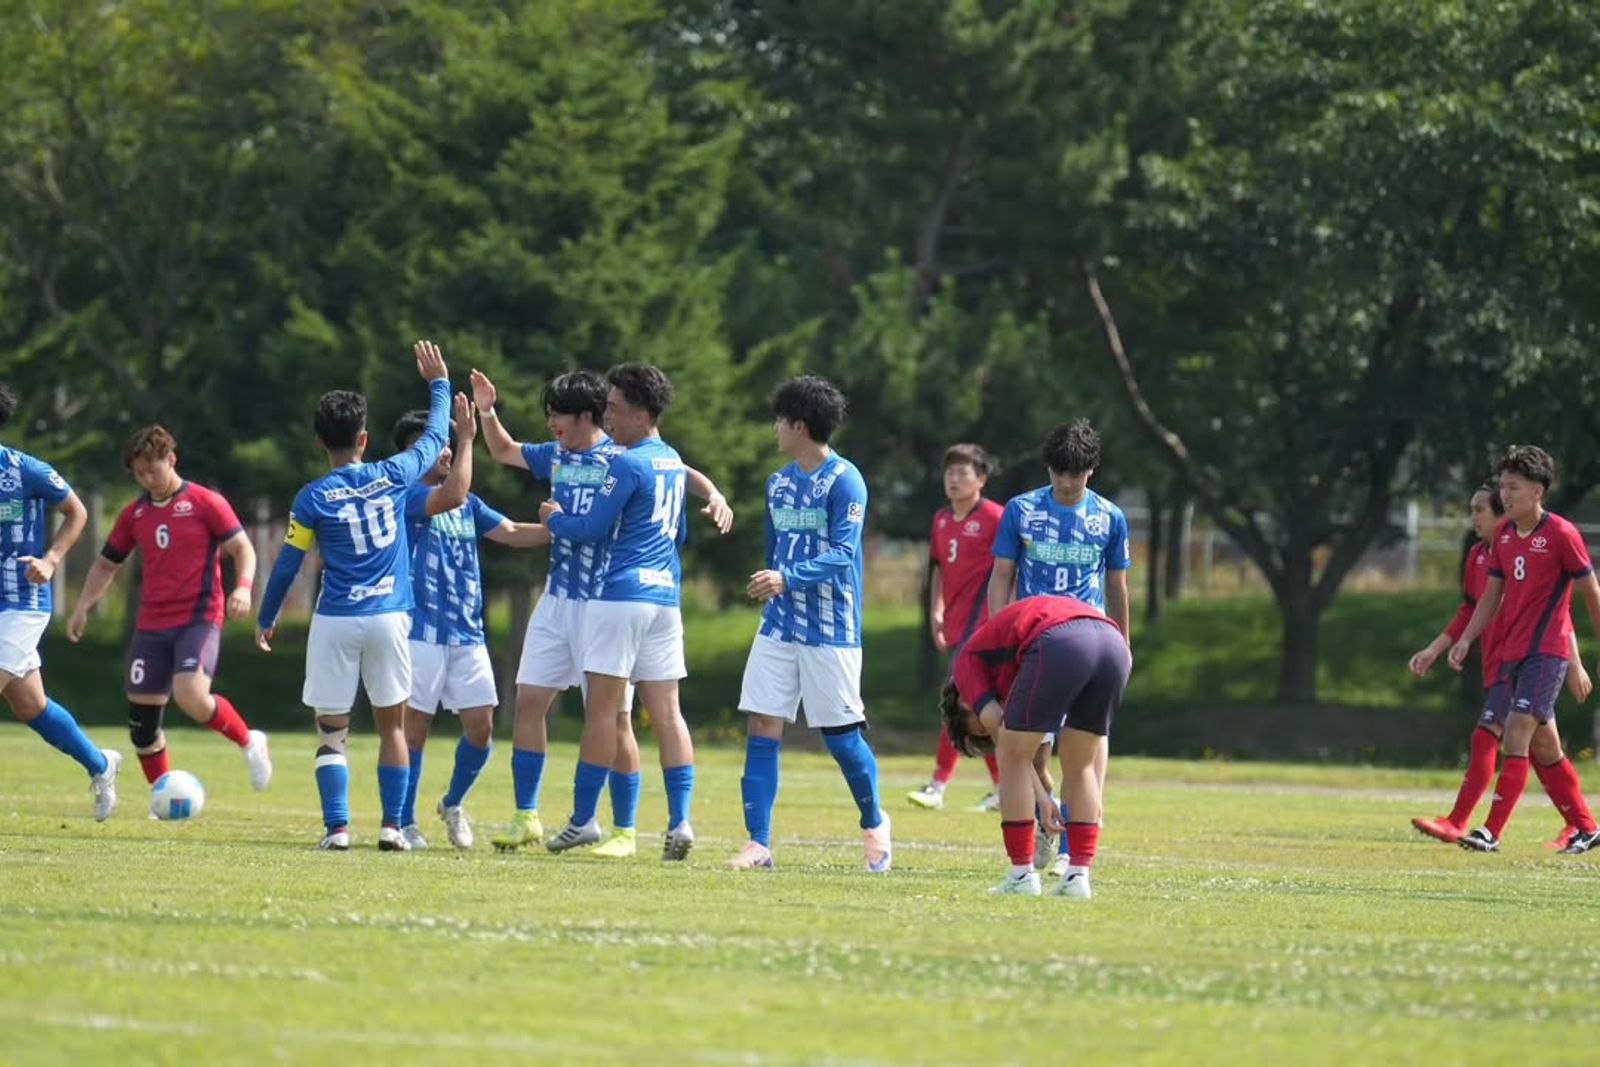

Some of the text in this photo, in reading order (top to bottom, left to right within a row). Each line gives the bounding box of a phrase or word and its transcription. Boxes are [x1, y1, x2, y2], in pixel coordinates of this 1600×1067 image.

[572, 488, 595, 515] 15
[155, 524, 169, 549] 6
[337, 495, 397, 556] 10
[788, 533, 801, 560] 7
[947, 538, 958, 563] 3
[1036, 544, 1093, 562] 明治安田
[1054, 567, 1069, 592] 8
[1513, 556, 1525, 580] 8
[130, 658, 145, 685] 6
